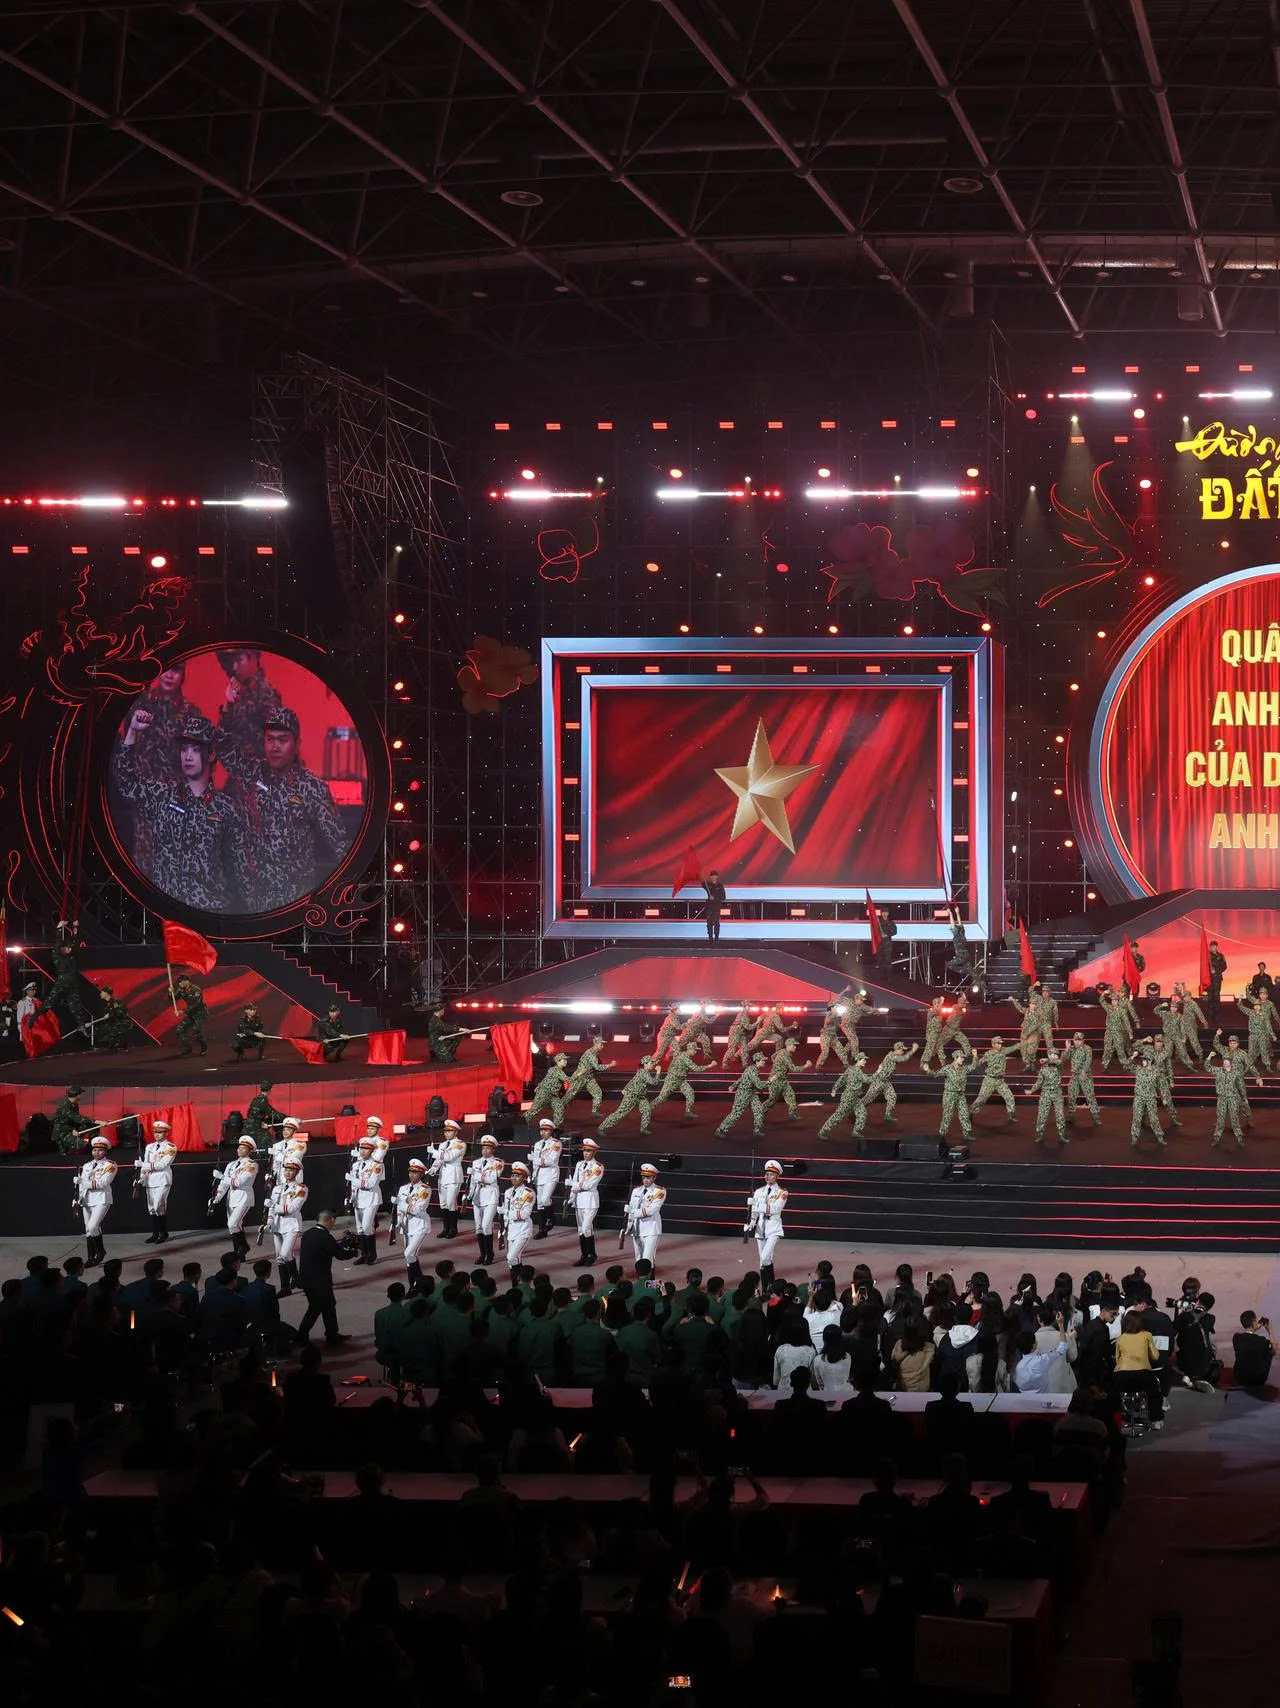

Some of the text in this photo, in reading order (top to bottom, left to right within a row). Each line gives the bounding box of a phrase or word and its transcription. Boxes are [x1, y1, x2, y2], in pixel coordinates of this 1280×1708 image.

[1211, 691, 1280, 726] ANH
[1185, 739, 1252, 788] CỦA
[1209, 813, 1279, 849] ANH
